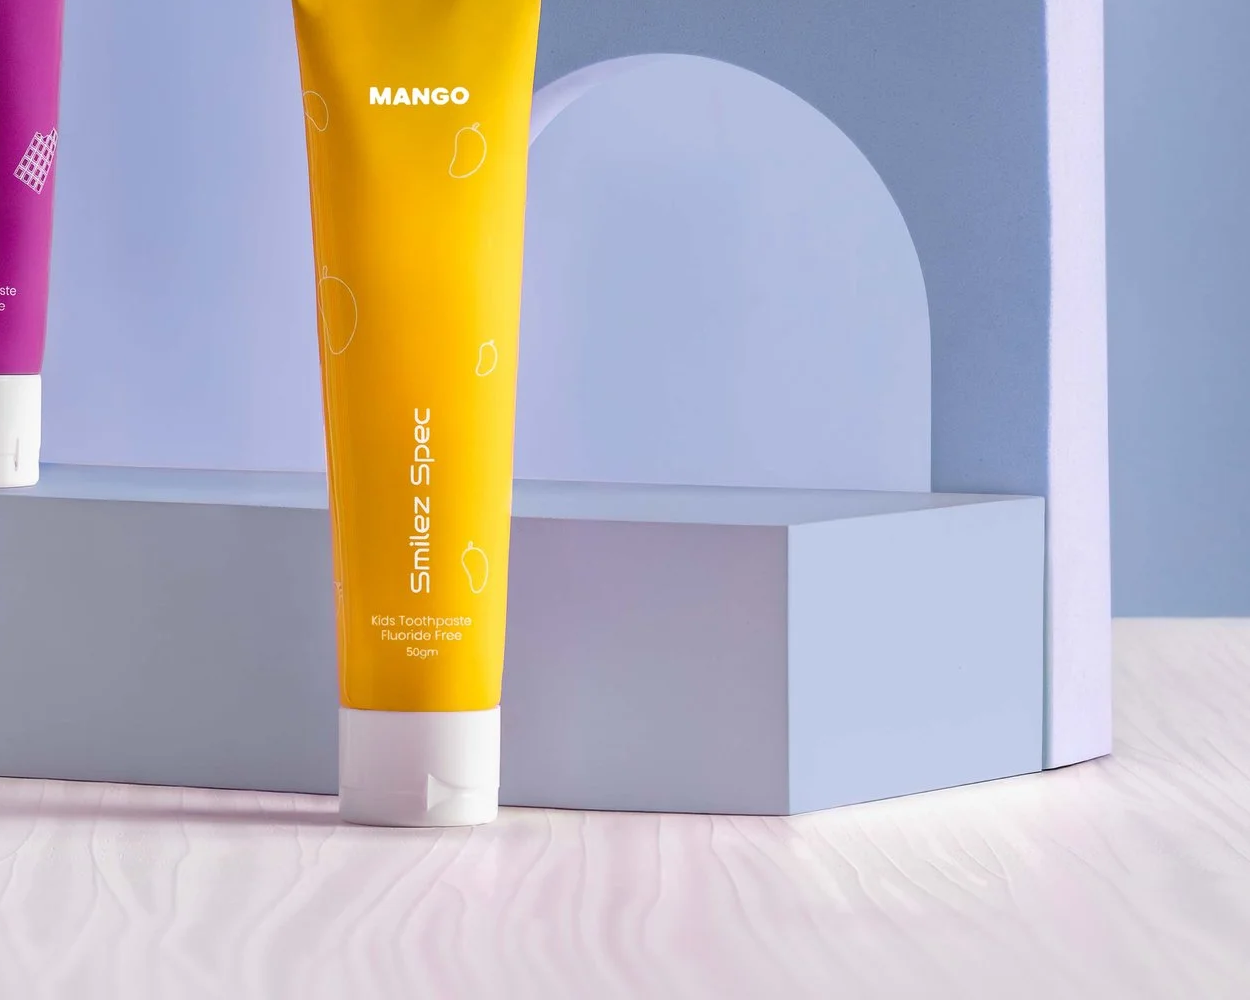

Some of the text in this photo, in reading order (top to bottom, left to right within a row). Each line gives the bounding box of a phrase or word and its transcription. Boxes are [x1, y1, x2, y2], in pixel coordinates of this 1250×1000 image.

[369, 86, 470, 105] MANGO
[409, 407, 435, 593] Smilez Spec
[371, 615, 472, 629] Kids Toothpaste
[381, 629, 462, 641] Fluoride Free
[406, 646, 439, 659] 50gm
